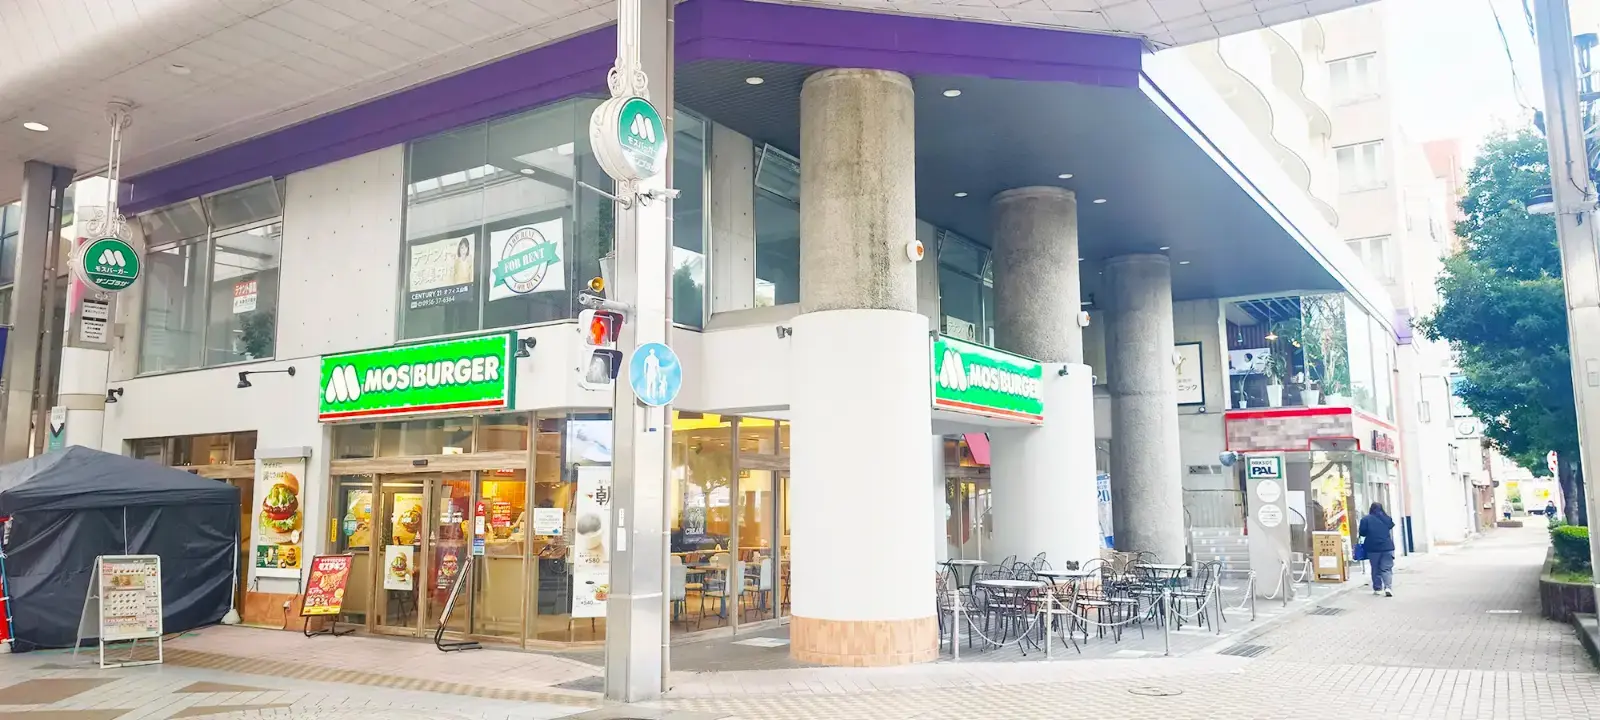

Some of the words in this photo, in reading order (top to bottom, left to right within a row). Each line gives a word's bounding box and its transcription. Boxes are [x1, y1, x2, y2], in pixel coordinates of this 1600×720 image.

[627, 135, 657, 155] モスバーガー
[95, 265, 129, 275] モスバーガー
[504, 256, 522, 274] FOR
[522, 247, 545, 266] RENT
[411, 290, 436, 301] CENTURY
[363, 364, 411, 393] MOS
[412, 355, 500, 389] BURGER
[969, 362, 1000, 392] MOS
[999, 368, 1042, 401] BURGE
[1252, 466, 1277, 475] PAL
